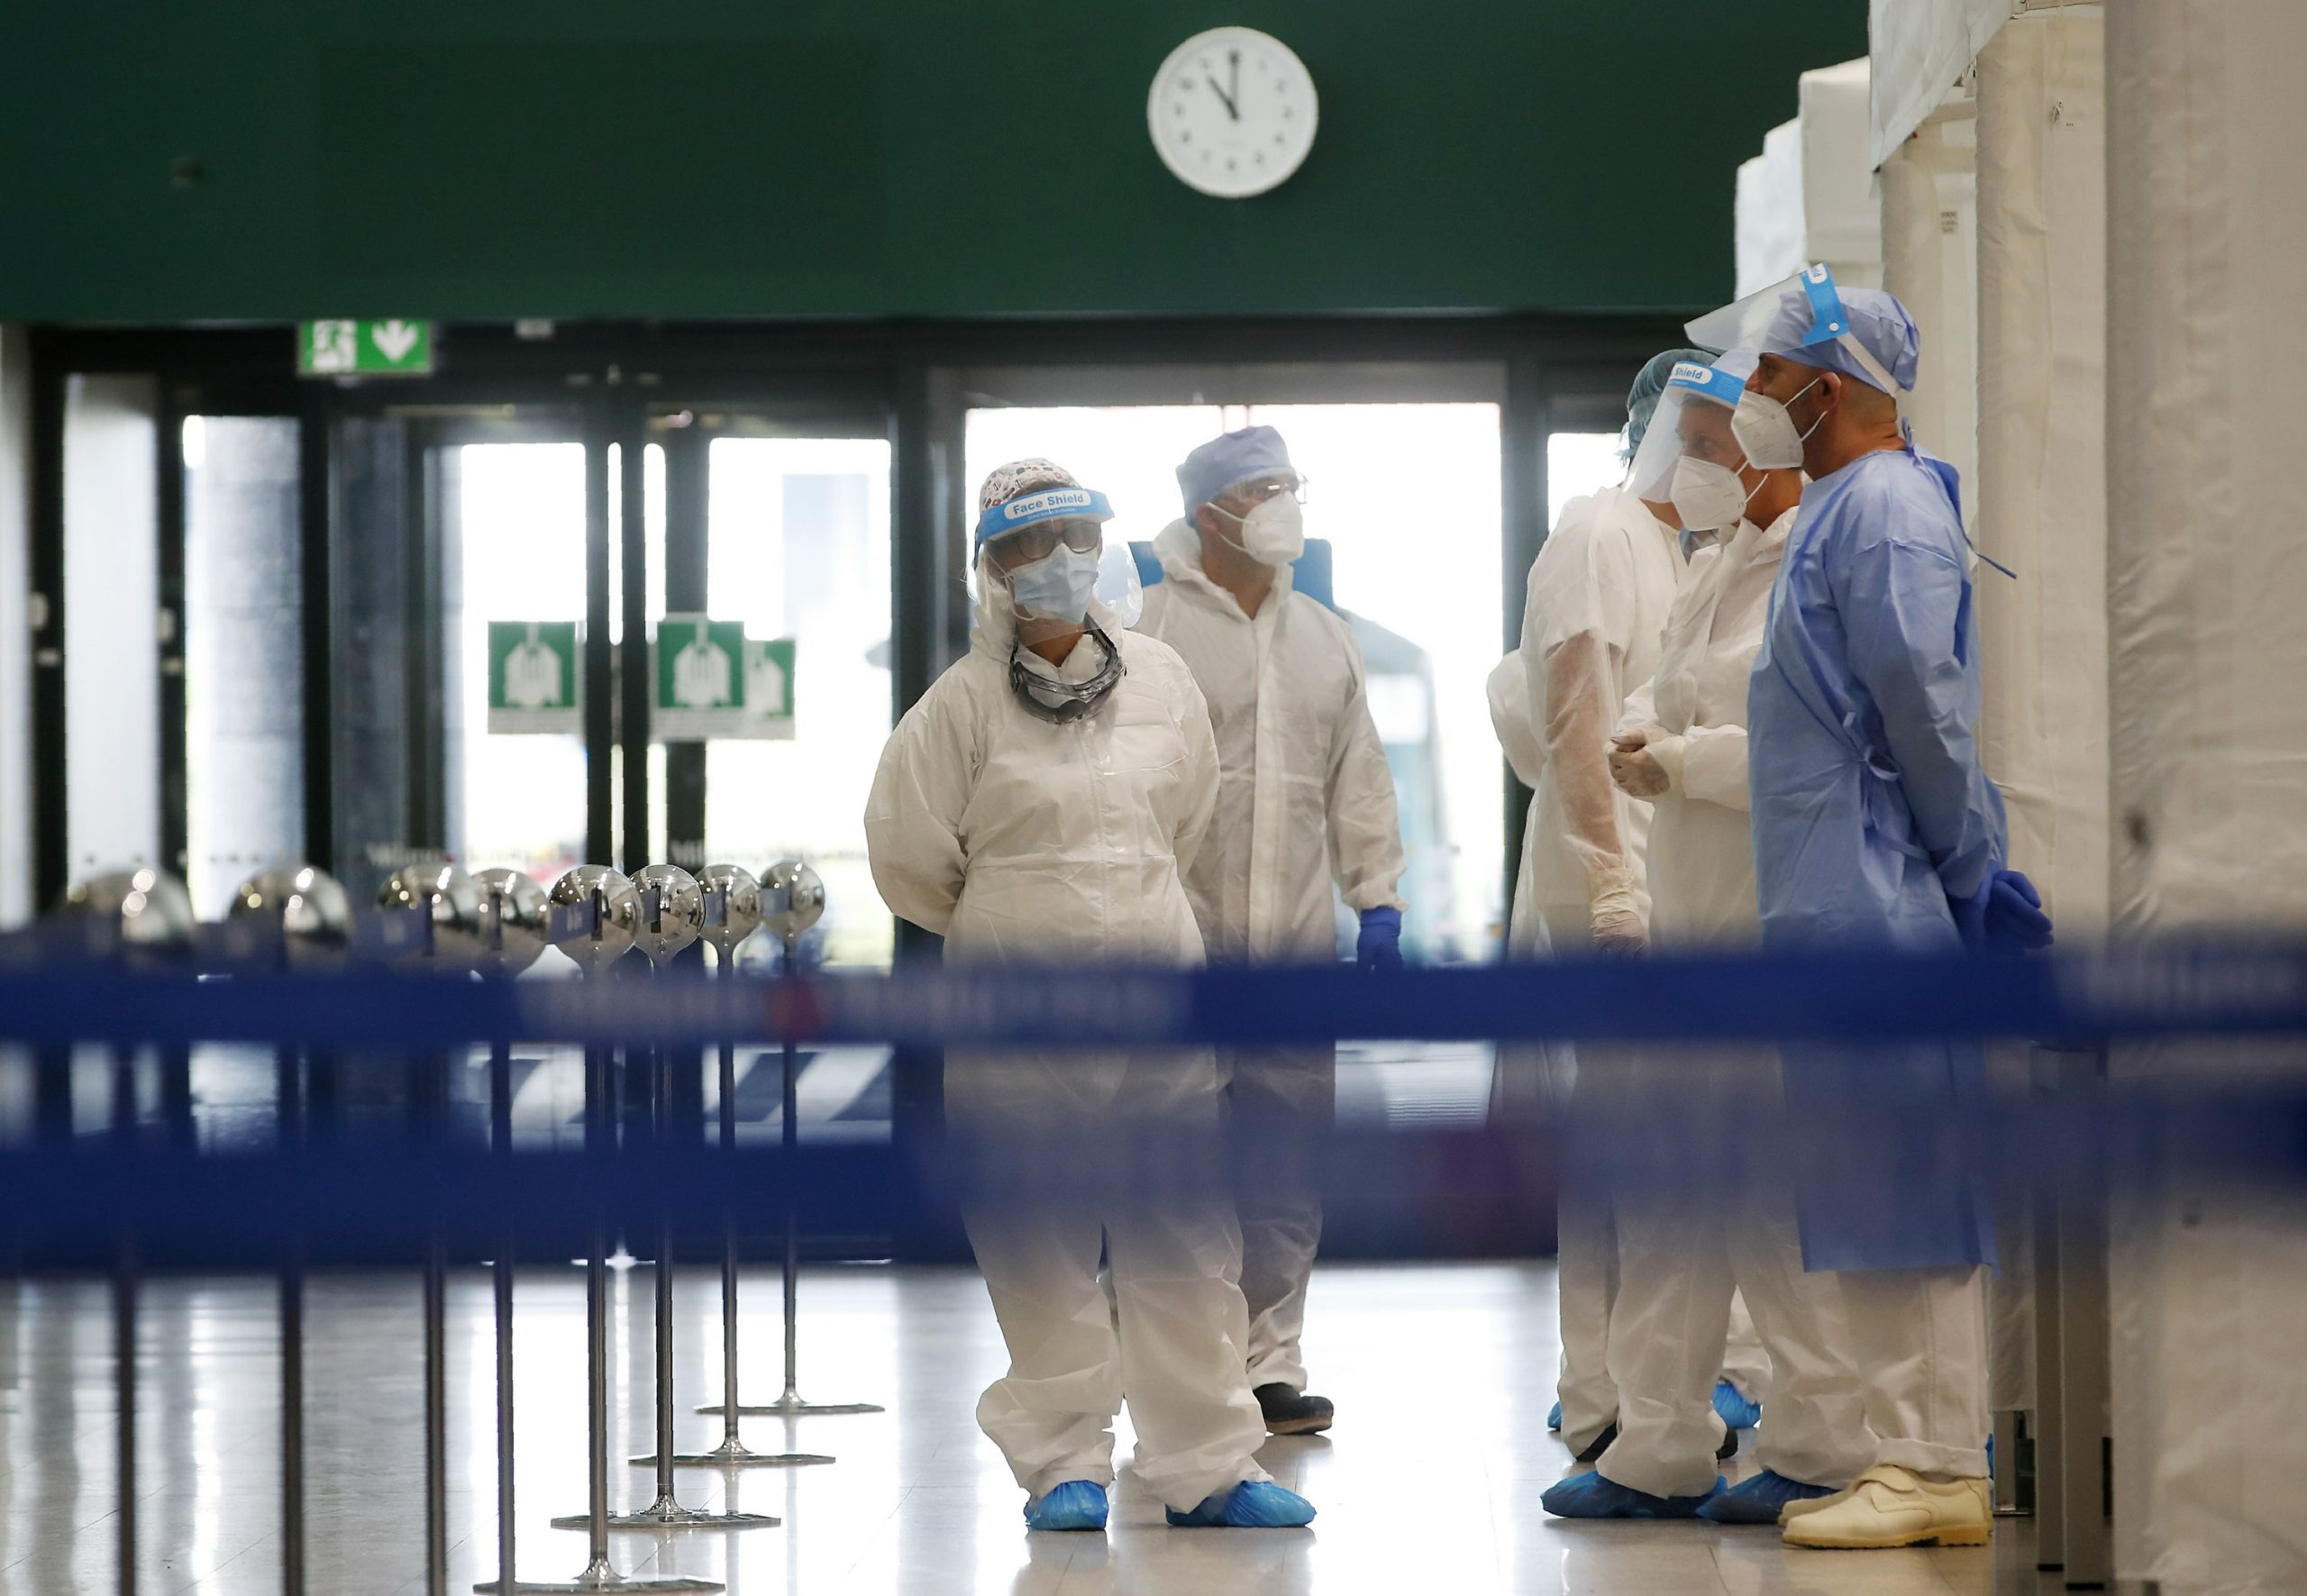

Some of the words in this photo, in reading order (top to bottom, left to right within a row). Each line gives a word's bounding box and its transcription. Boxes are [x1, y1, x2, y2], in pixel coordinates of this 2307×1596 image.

[1675, 367, 1702, 379] Shield
[1013, 500, 1043, 515] Face
[1047, 494, 1083, 506] Shield
